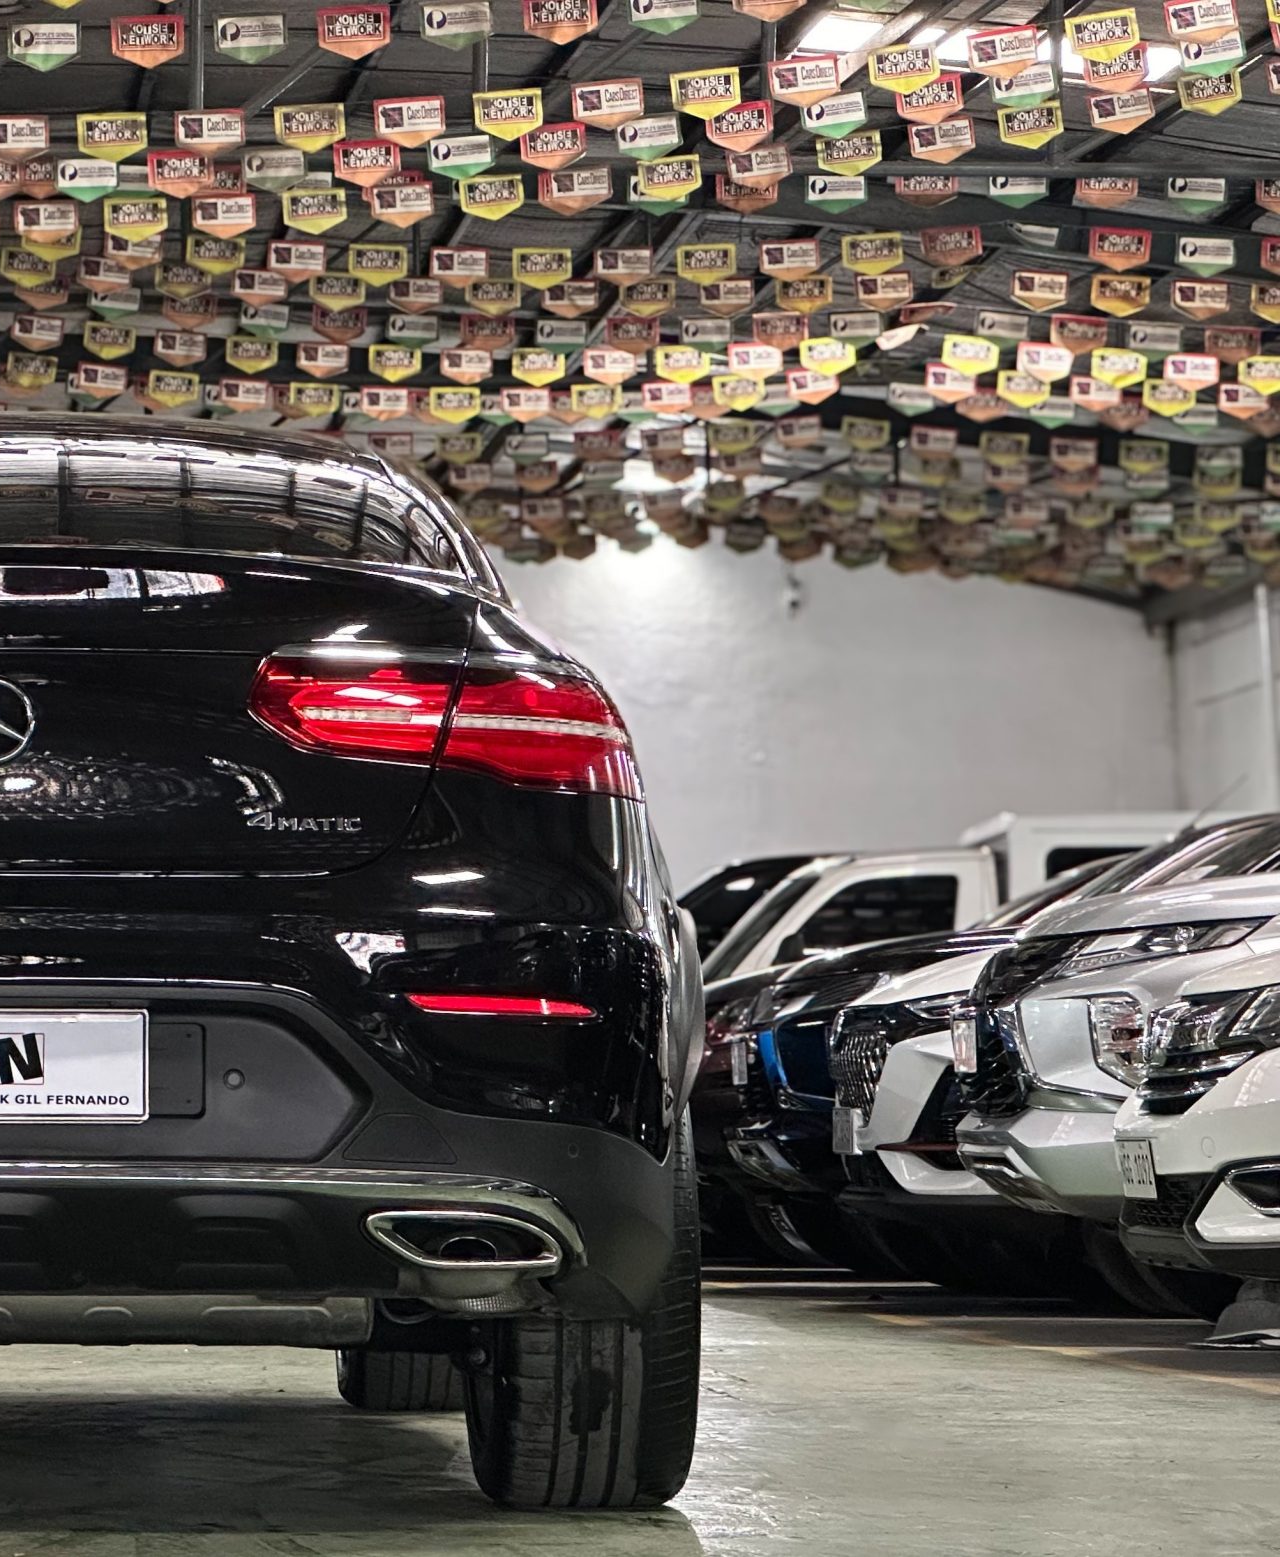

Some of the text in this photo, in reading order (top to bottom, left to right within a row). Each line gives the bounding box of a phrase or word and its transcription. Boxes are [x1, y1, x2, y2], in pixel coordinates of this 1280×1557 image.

[539, 0, 579, 11] KOTSE
[333, 14, 373, 25] KOTSE
[532, 8, 588, 22] NETWORK
[129, 24, 168, 34] KOTSE
[327, 24, 381, 37] NETWORK
[1082, 17, 1120, 33] KOTSE
[121, 34, 174, 45] NETWORK
[1076, 26, 1131, 44] NETWORK
[686, 75, 724, 87] KOTSE
[680, 86, 731, 99] NETWORK
[489, 96, 527, 108] KOTSE
[483, 106, 534, 119] NETWORK
[722, 110, 757, 122] KOTSE
[715, 119, 765, 134] NETWORK
[246, 811, 363, 832] 4MATIC
[14, 1094, 42, 1105] GIL
[46, 1095, 130, 1106] FERNANDO
